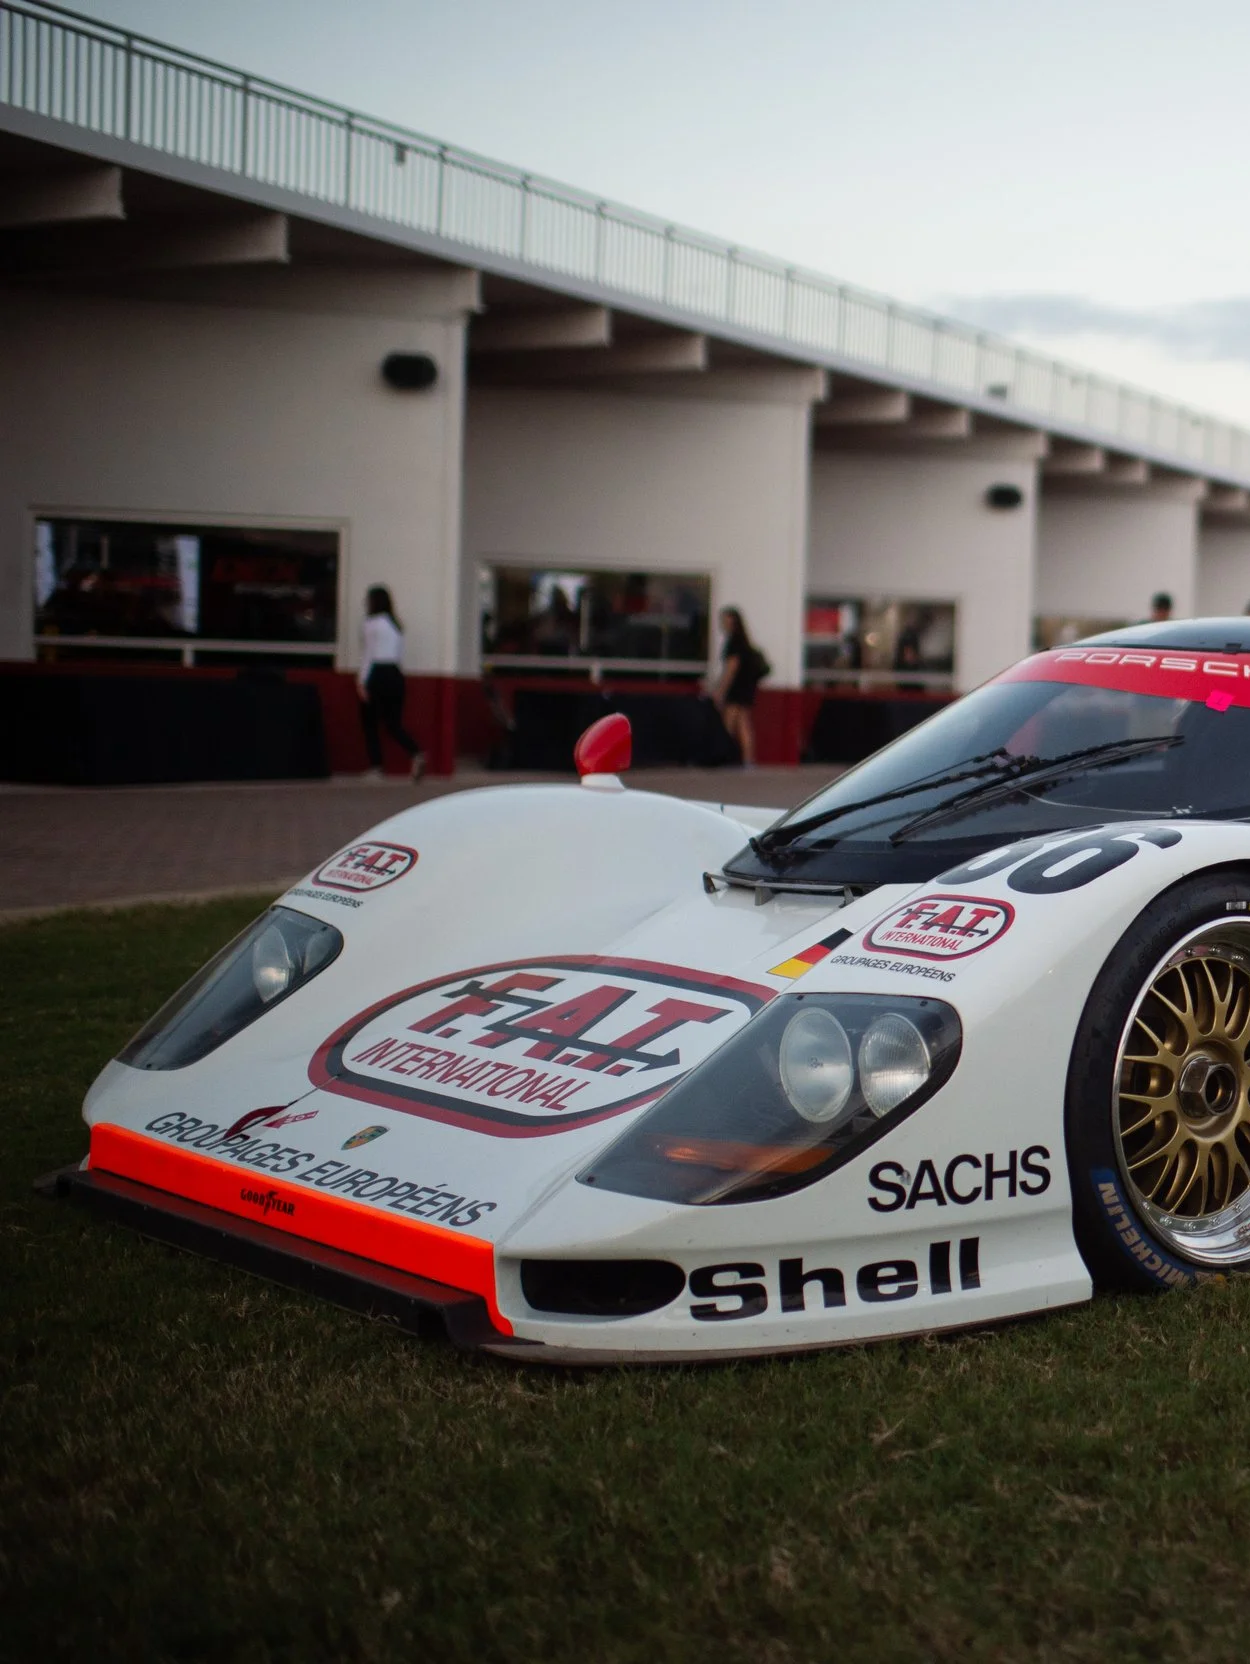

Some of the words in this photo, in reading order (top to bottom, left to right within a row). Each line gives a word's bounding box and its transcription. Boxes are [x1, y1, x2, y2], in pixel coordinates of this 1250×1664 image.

[830, 955, 891, 969] GROUPAGES
[888, 961, 956, 983] EUROPÉENS
[879, 930, 963, 951] INTERNATIONAL
[351, 1037, 591, 1112] INTERNATIONAL
[144, 1111, 312, 1174] GROUPAGES
[294, 1159, 498, 1227] EUROPÉENS
[240, 1187, 296, 1217] GOODYEAR
[867, 1145, 1051, 1213] SACHS
[1097, 1182, 1190, 1286] MICHELIN
[689, 1237, 981, 1322] Shell
